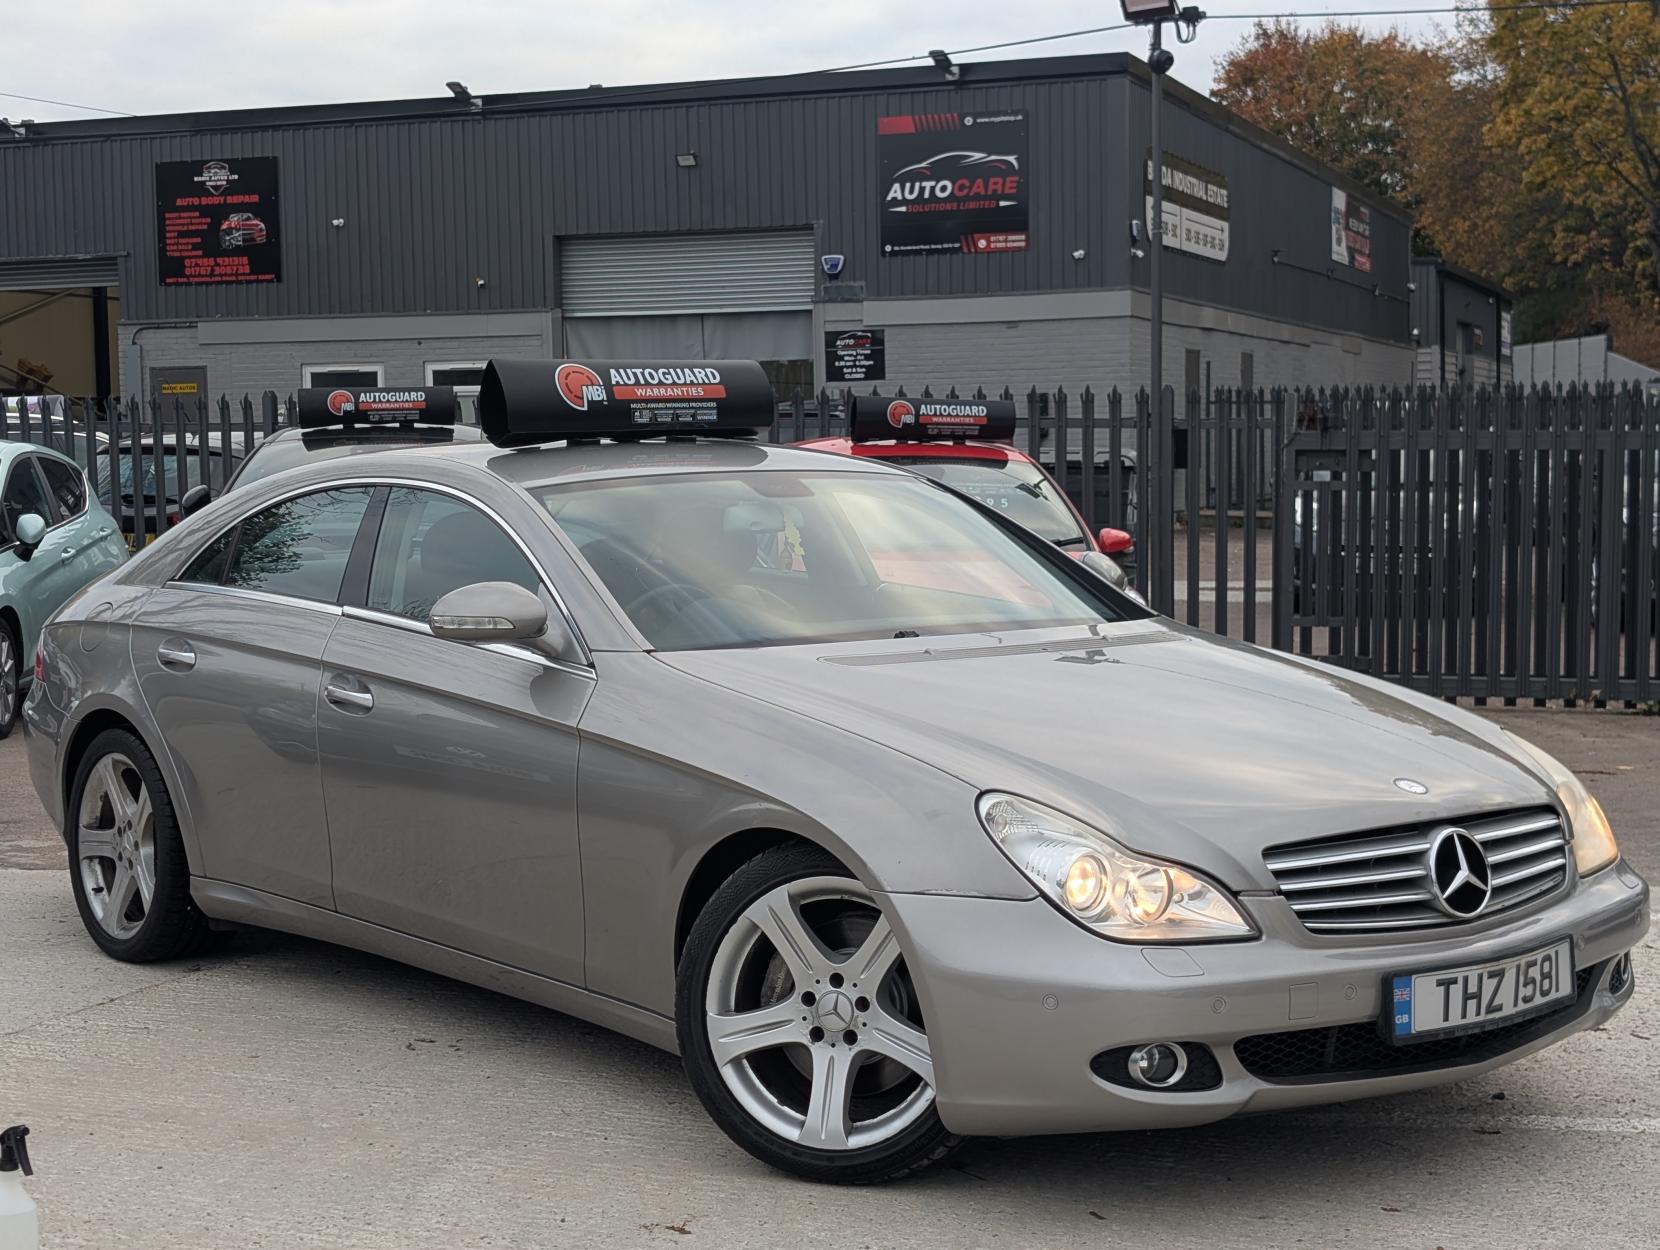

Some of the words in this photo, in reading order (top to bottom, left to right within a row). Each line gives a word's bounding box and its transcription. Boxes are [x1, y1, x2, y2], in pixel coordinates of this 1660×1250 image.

[886, 176, 1019, 201] AUTOCARE
[1172, 169, 1207, 201] INDUSTRIAL
[1207, 183, 1228, 208] ESTATE
[175, 197, 200, 206] AUTO
[200, 195, 225, 205] BODY
[226, 194, 260, 204] REPAIR
[907, 202, 958, 213] SOLUTIONS
[960, 200, 996, 210] LIMITED
[609, 367, 721, 385] AUTOGUARD
[359, 391, 426, 403] AUTOGUARD
[635, 387, 705, 397] WARRANTIES
[919, 404, 988, 417] AUTOGUARD
[931, 416, 975, 424] WARRANTIES
[1435, 967, 1506, 1023] THZ
[1512, 949, 1560, 1009] 1581
[1394, 1014, 1410, 1024] GB
